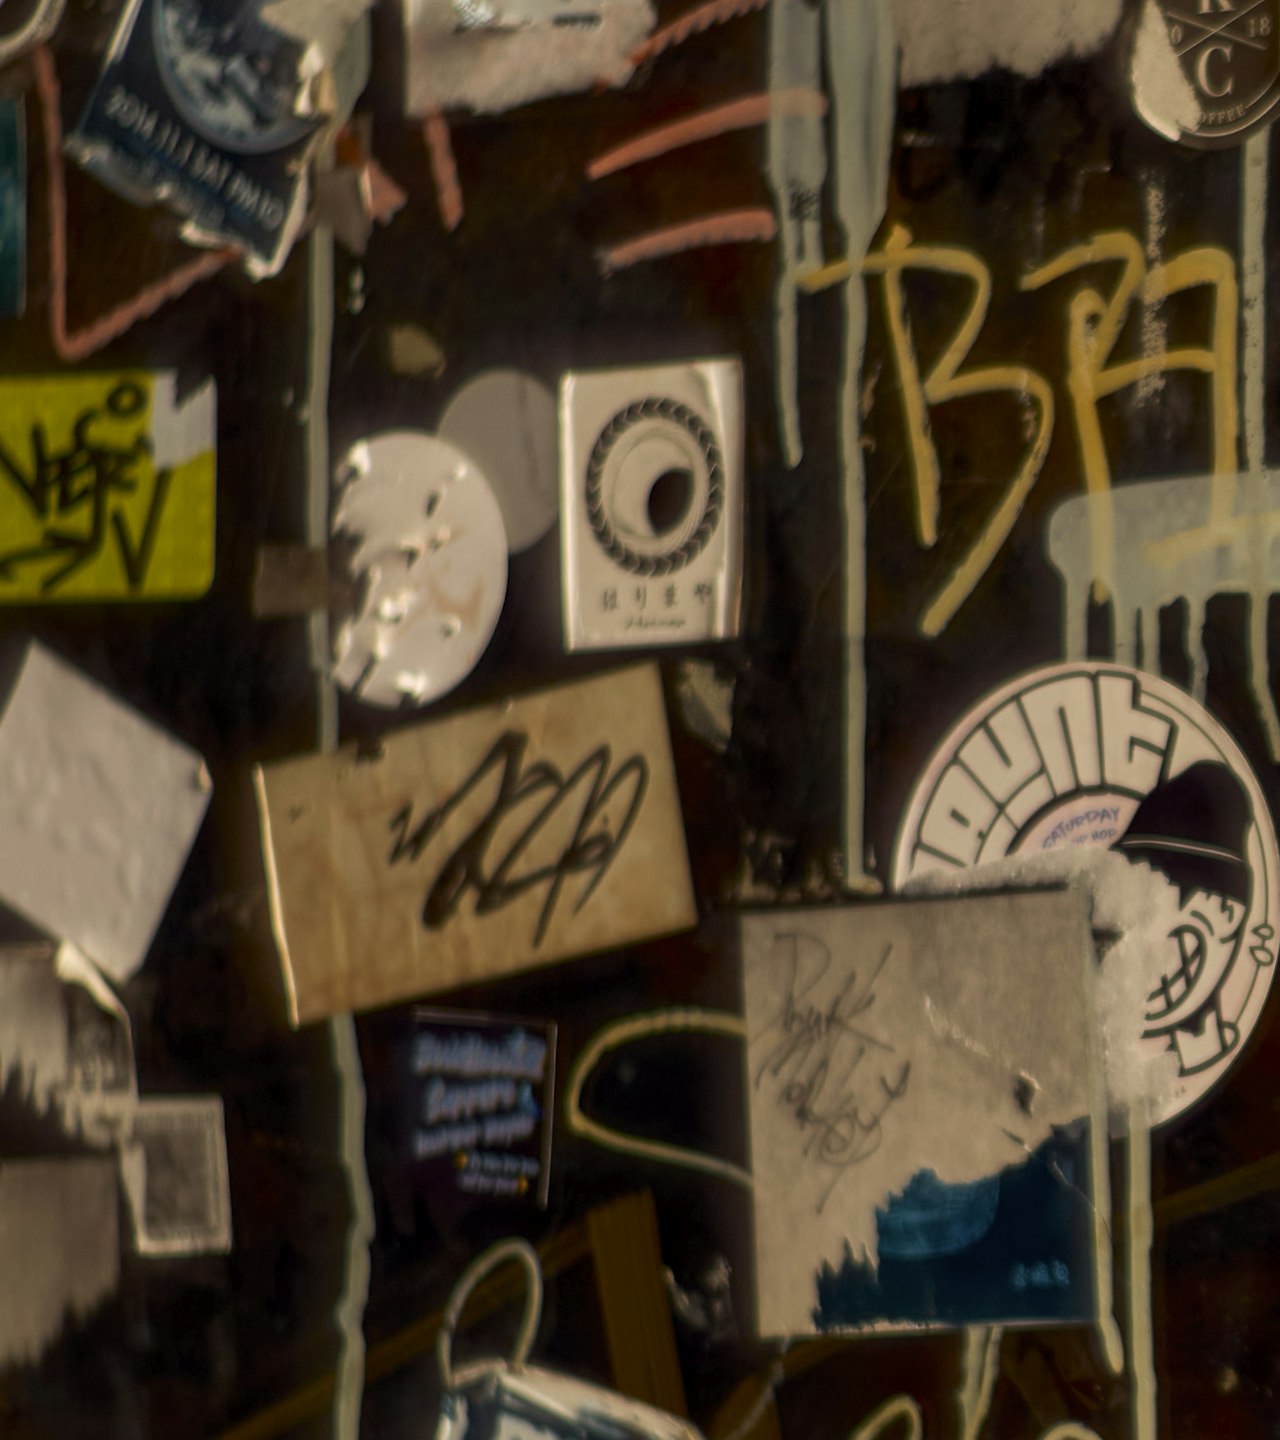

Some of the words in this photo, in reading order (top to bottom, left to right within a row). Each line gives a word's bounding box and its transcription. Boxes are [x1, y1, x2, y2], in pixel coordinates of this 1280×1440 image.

[1249, 17, 1274, 38] 18
[1197, 43, 1234, 98] C
[1198, 104, 1248, 126] OFFEE
[194, 145, 233, 193] SAT
